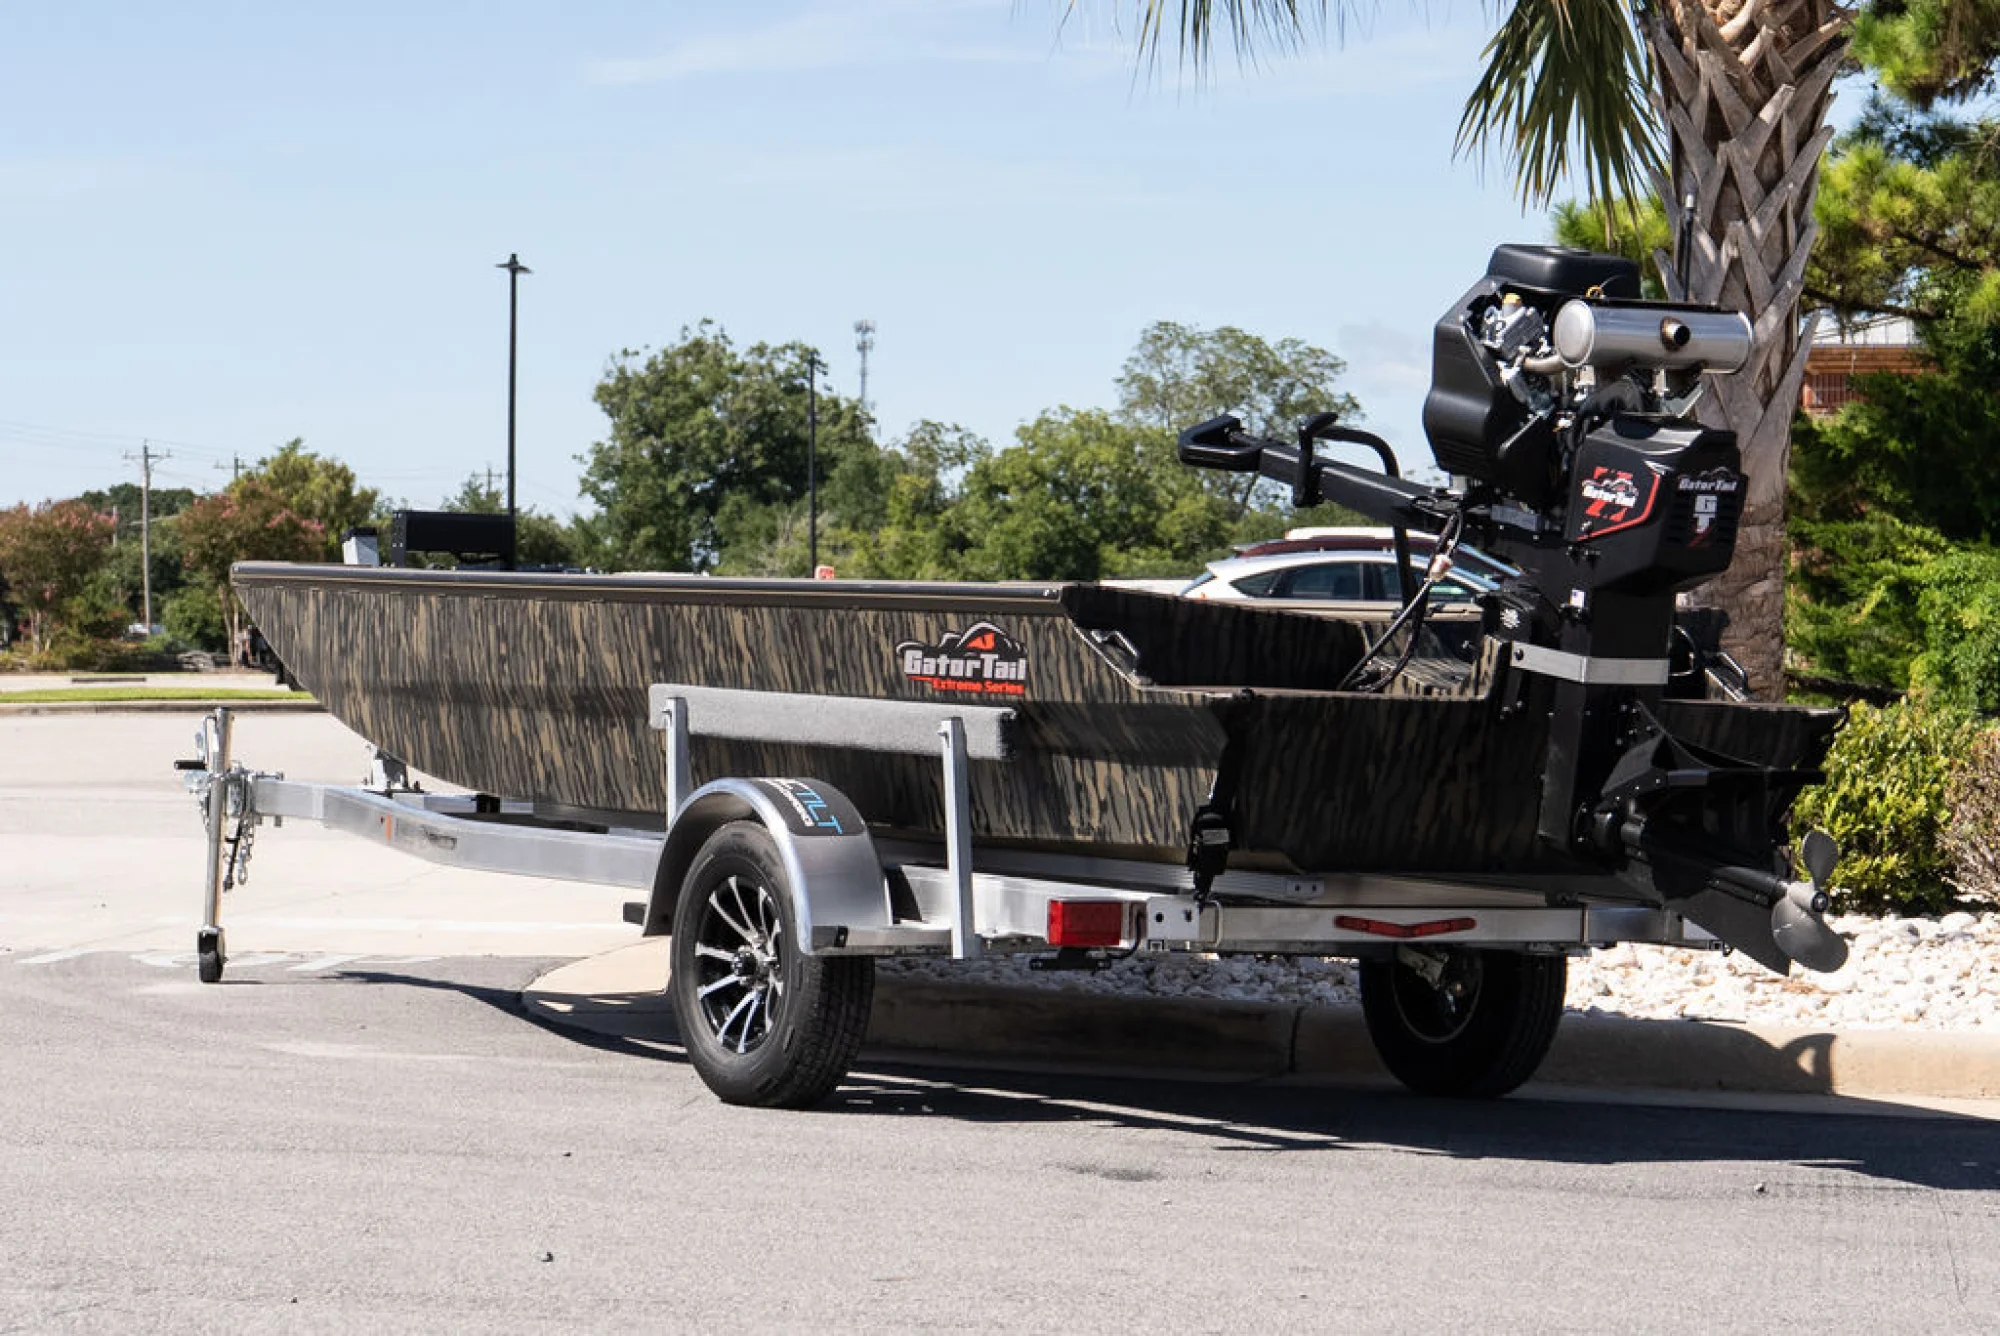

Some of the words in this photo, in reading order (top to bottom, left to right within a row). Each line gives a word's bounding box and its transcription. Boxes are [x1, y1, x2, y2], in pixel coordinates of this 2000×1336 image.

[1678, 478, 1738, 491] GatorTail
[904, 649, 1026, 680] GatorTail
[932, 678, 983, 692] Extreme
[984, 680, 1025, 695] Series
